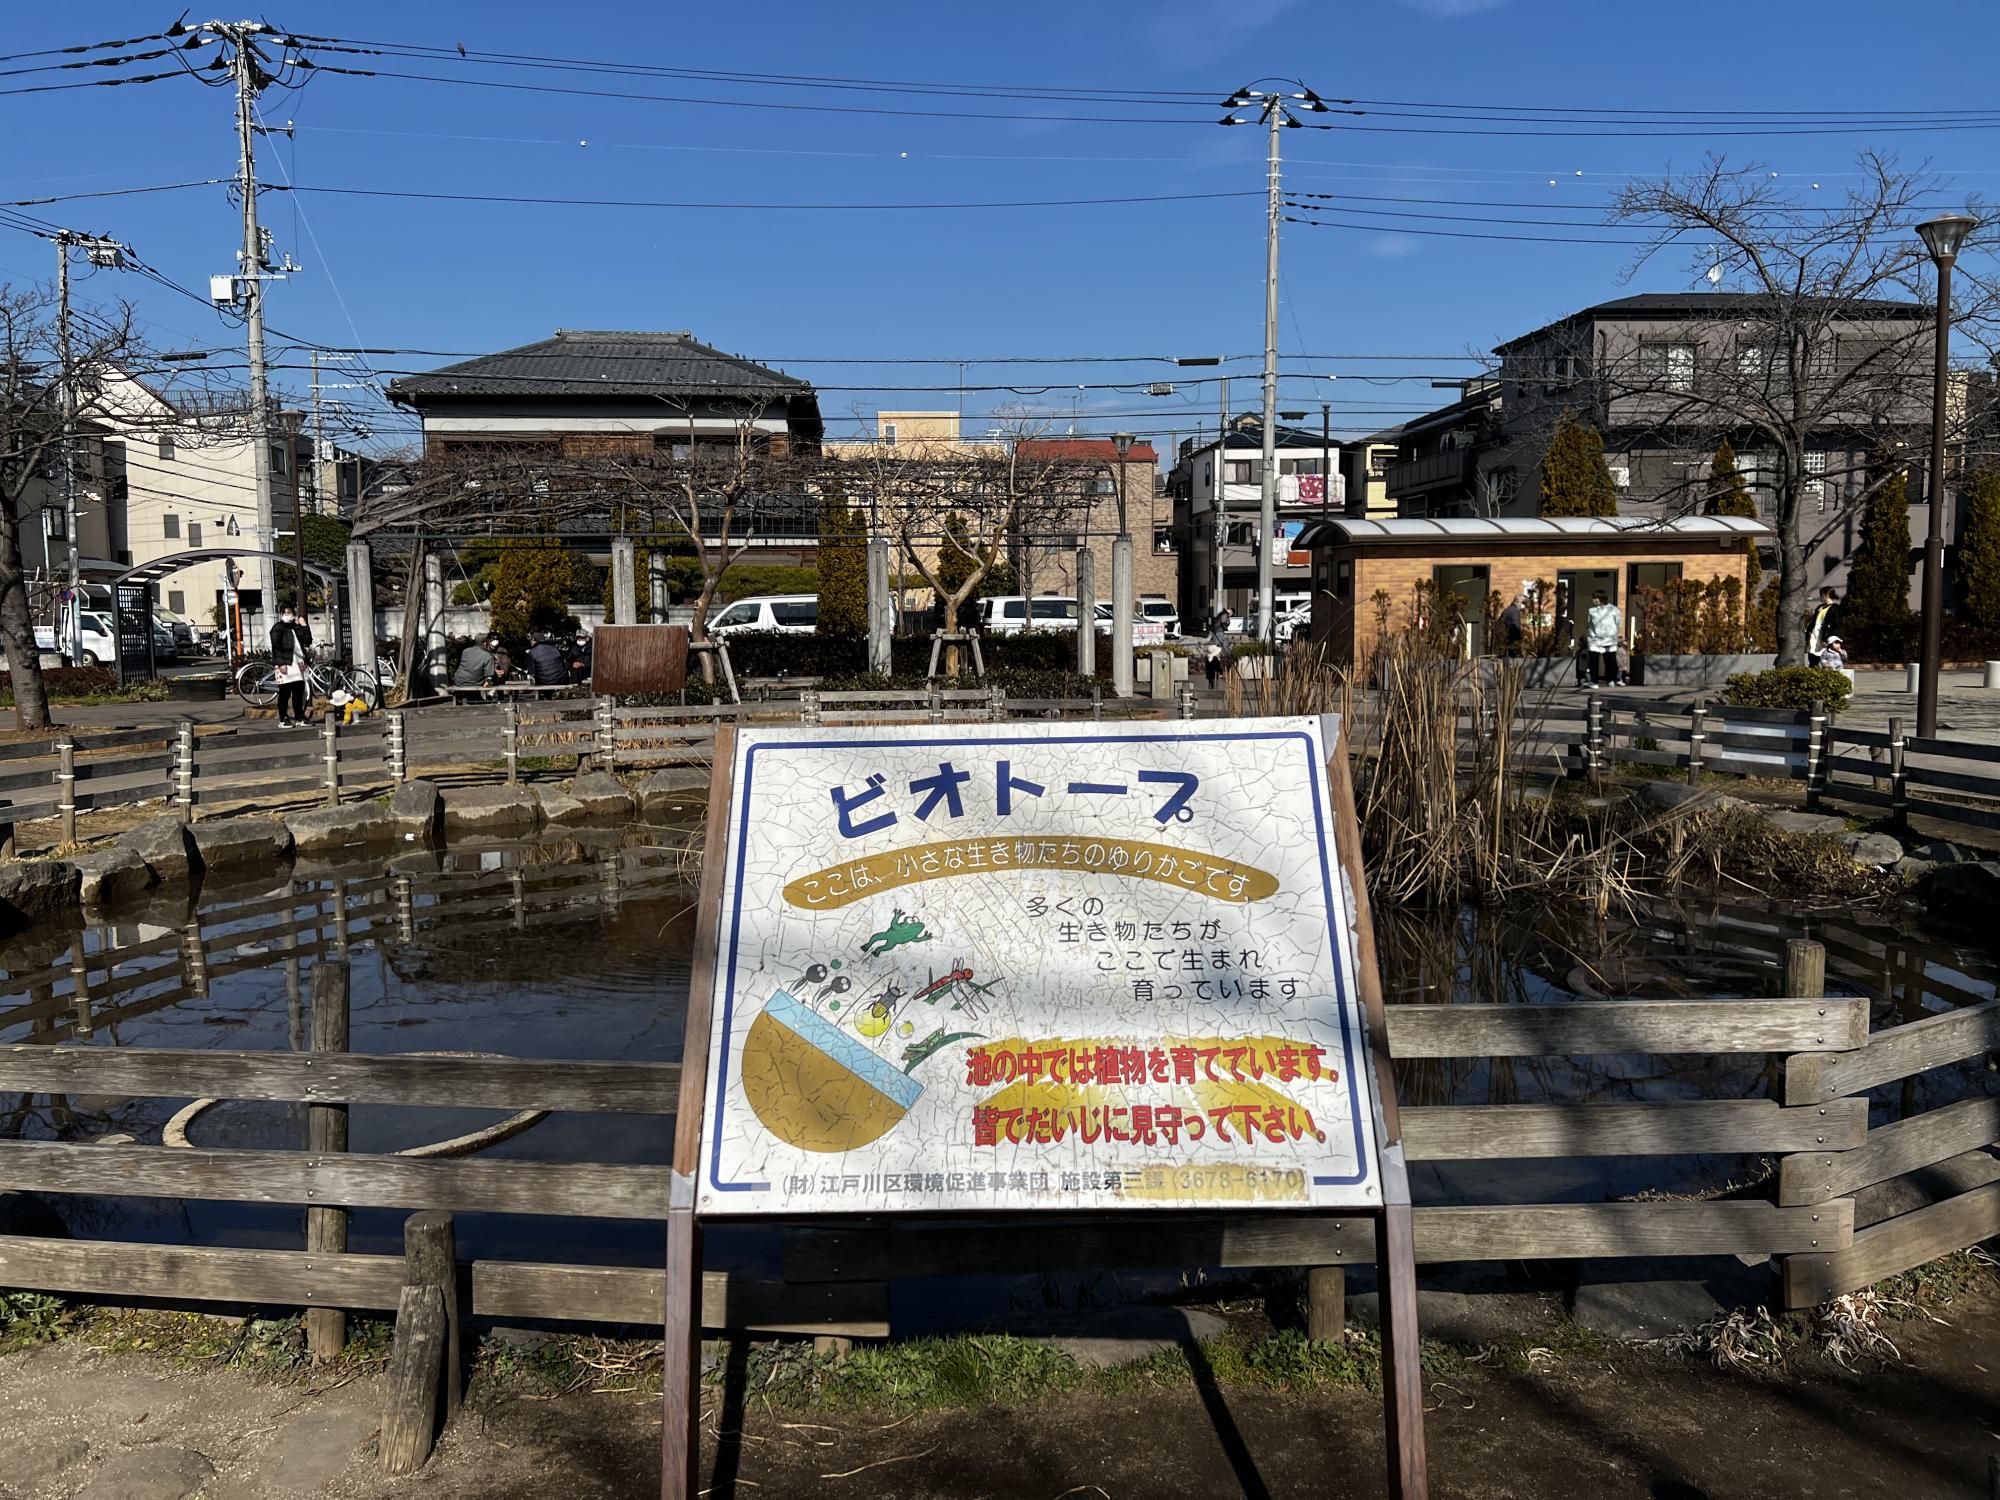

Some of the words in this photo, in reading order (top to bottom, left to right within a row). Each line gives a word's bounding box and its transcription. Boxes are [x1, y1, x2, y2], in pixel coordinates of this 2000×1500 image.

[830, 760, 1199, 838] ビオトープ
[1026, 896, 1104, 918] 多くの
[1058, 918, 1221, 943] 生き物たちが
[1096, 948, 1263, 971] ここで生まれ
[1131, 977, 1300, 1001] 育っています
[966, 1044, 1339, 1087] 池の中では植物を育てています。
[971, 1104, 1326, 1146] 皆でだいじに見守って下さい。
